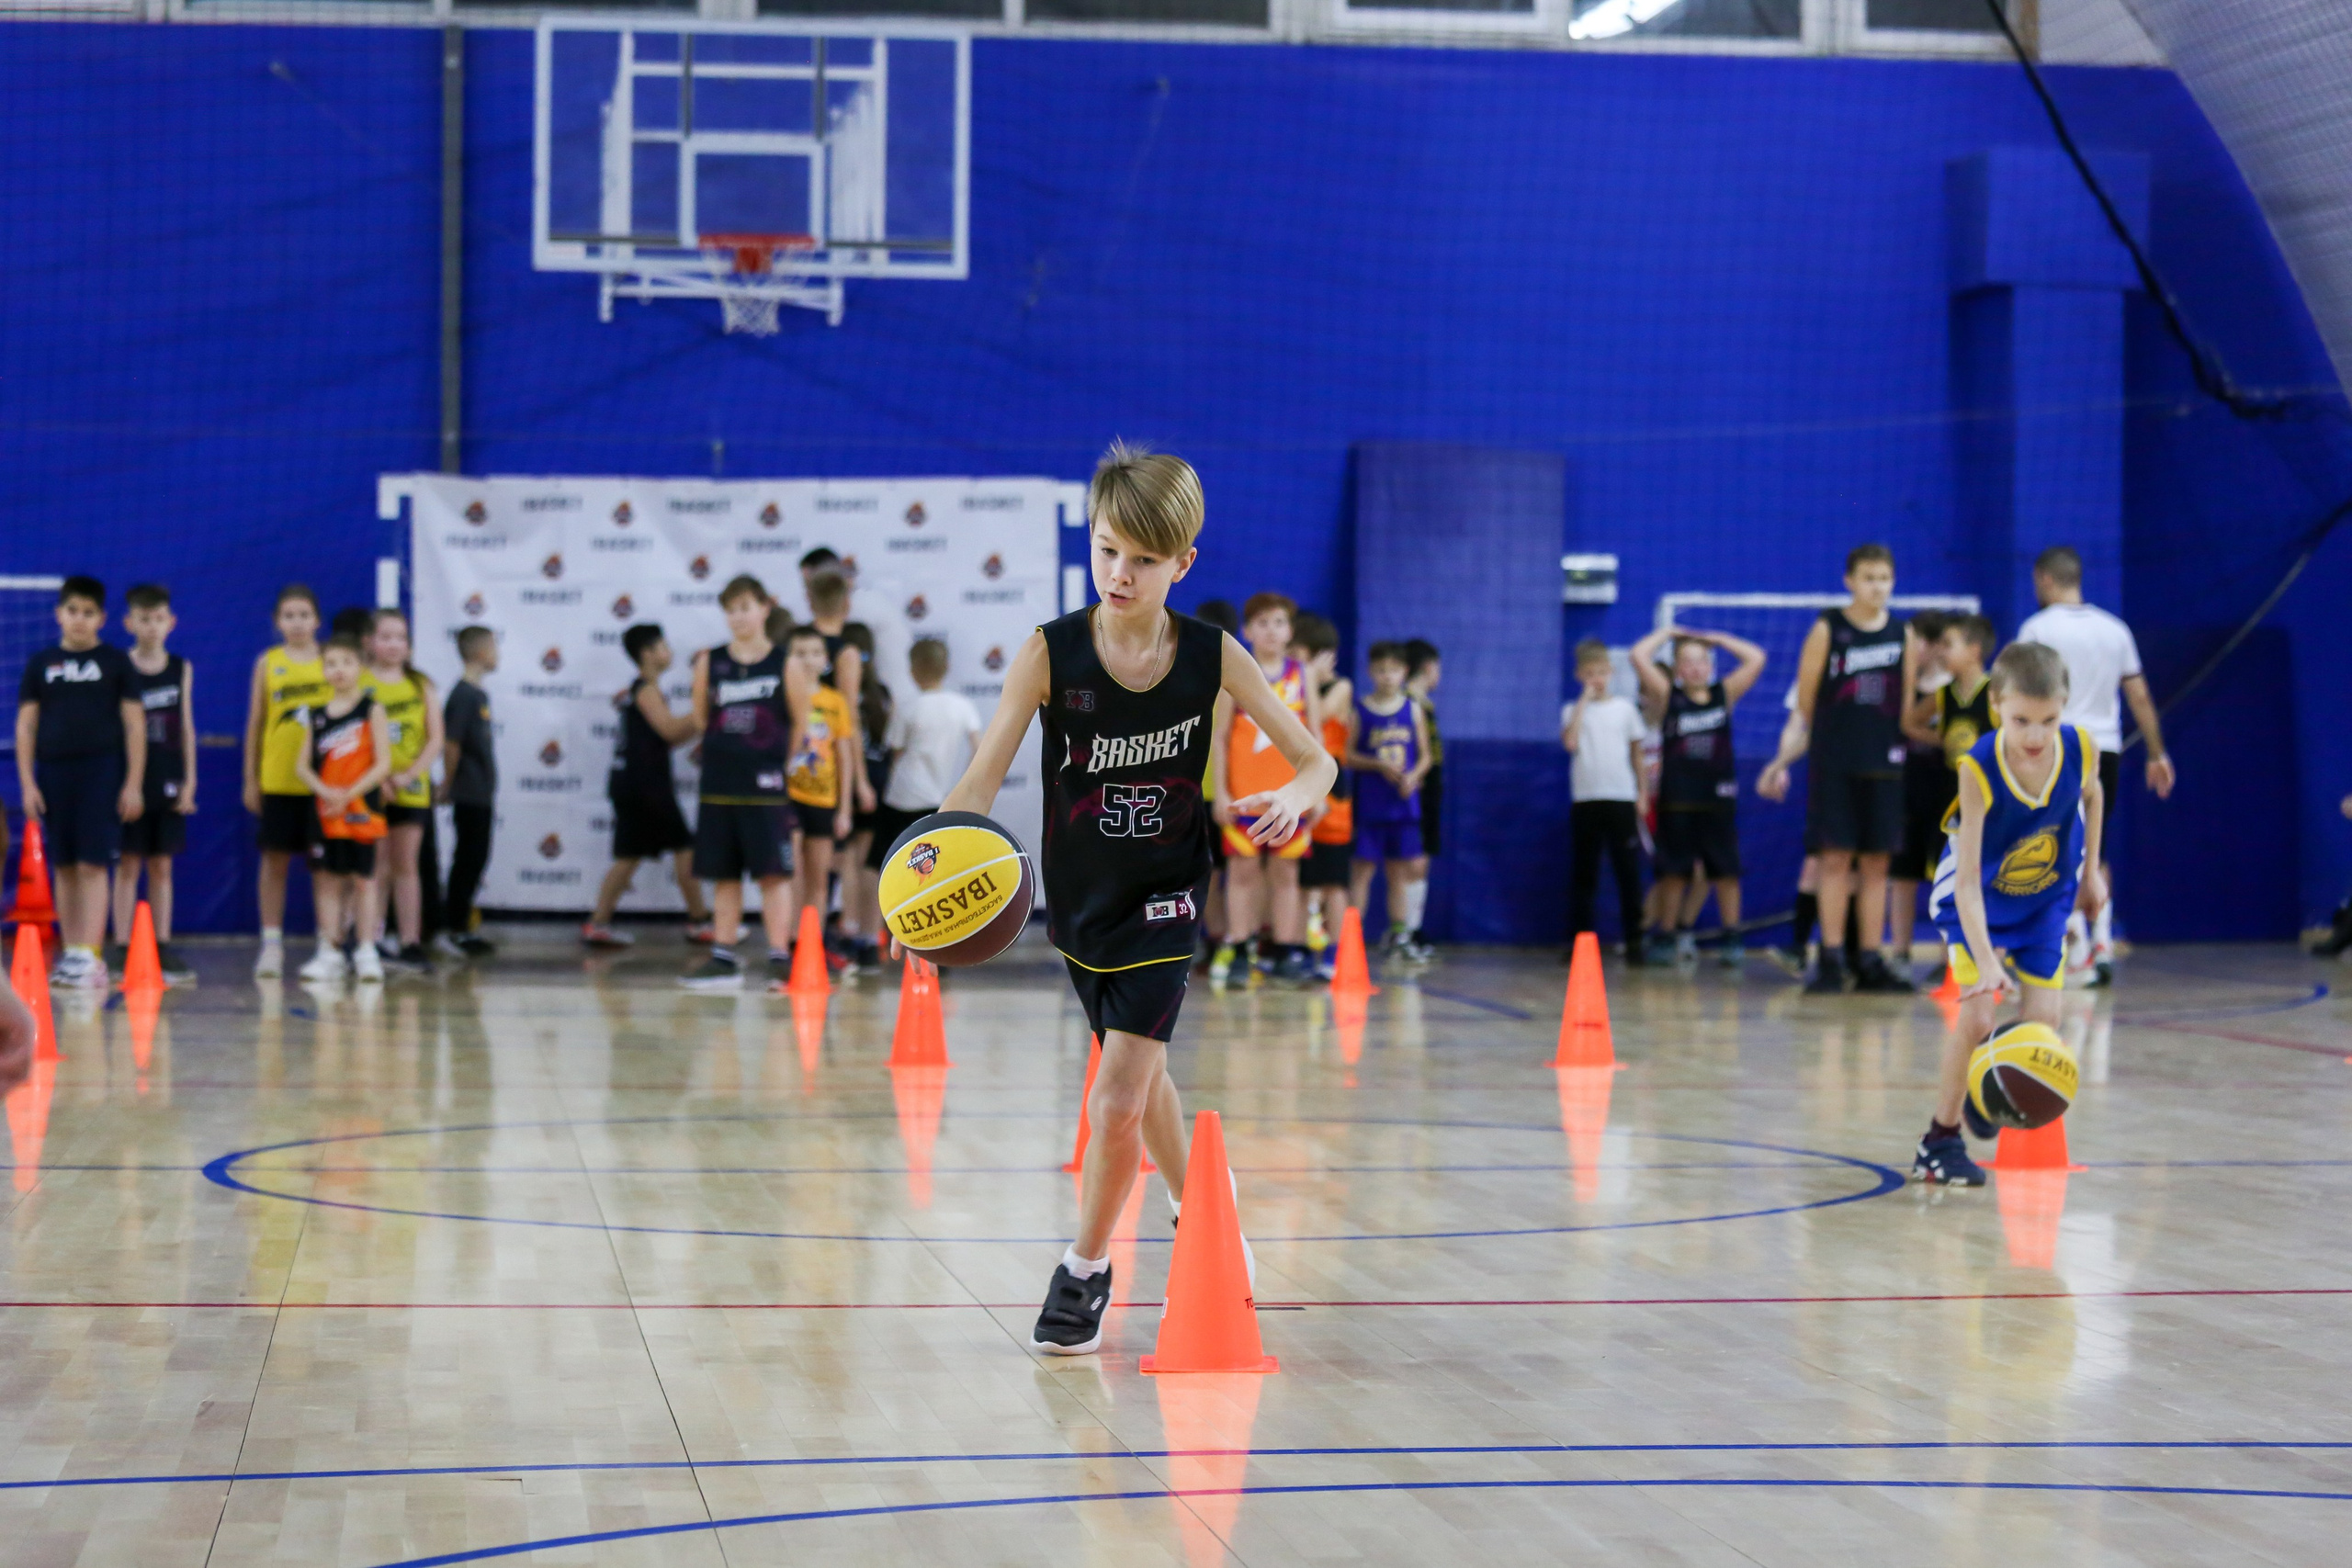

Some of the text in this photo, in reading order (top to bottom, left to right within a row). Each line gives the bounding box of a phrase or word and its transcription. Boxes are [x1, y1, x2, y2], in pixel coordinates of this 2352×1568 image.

[1086, 715, 1202, 775] BASKET
[1099, 783, 1167, 838] 52
[897, 871, 998, 934] IBASKET
